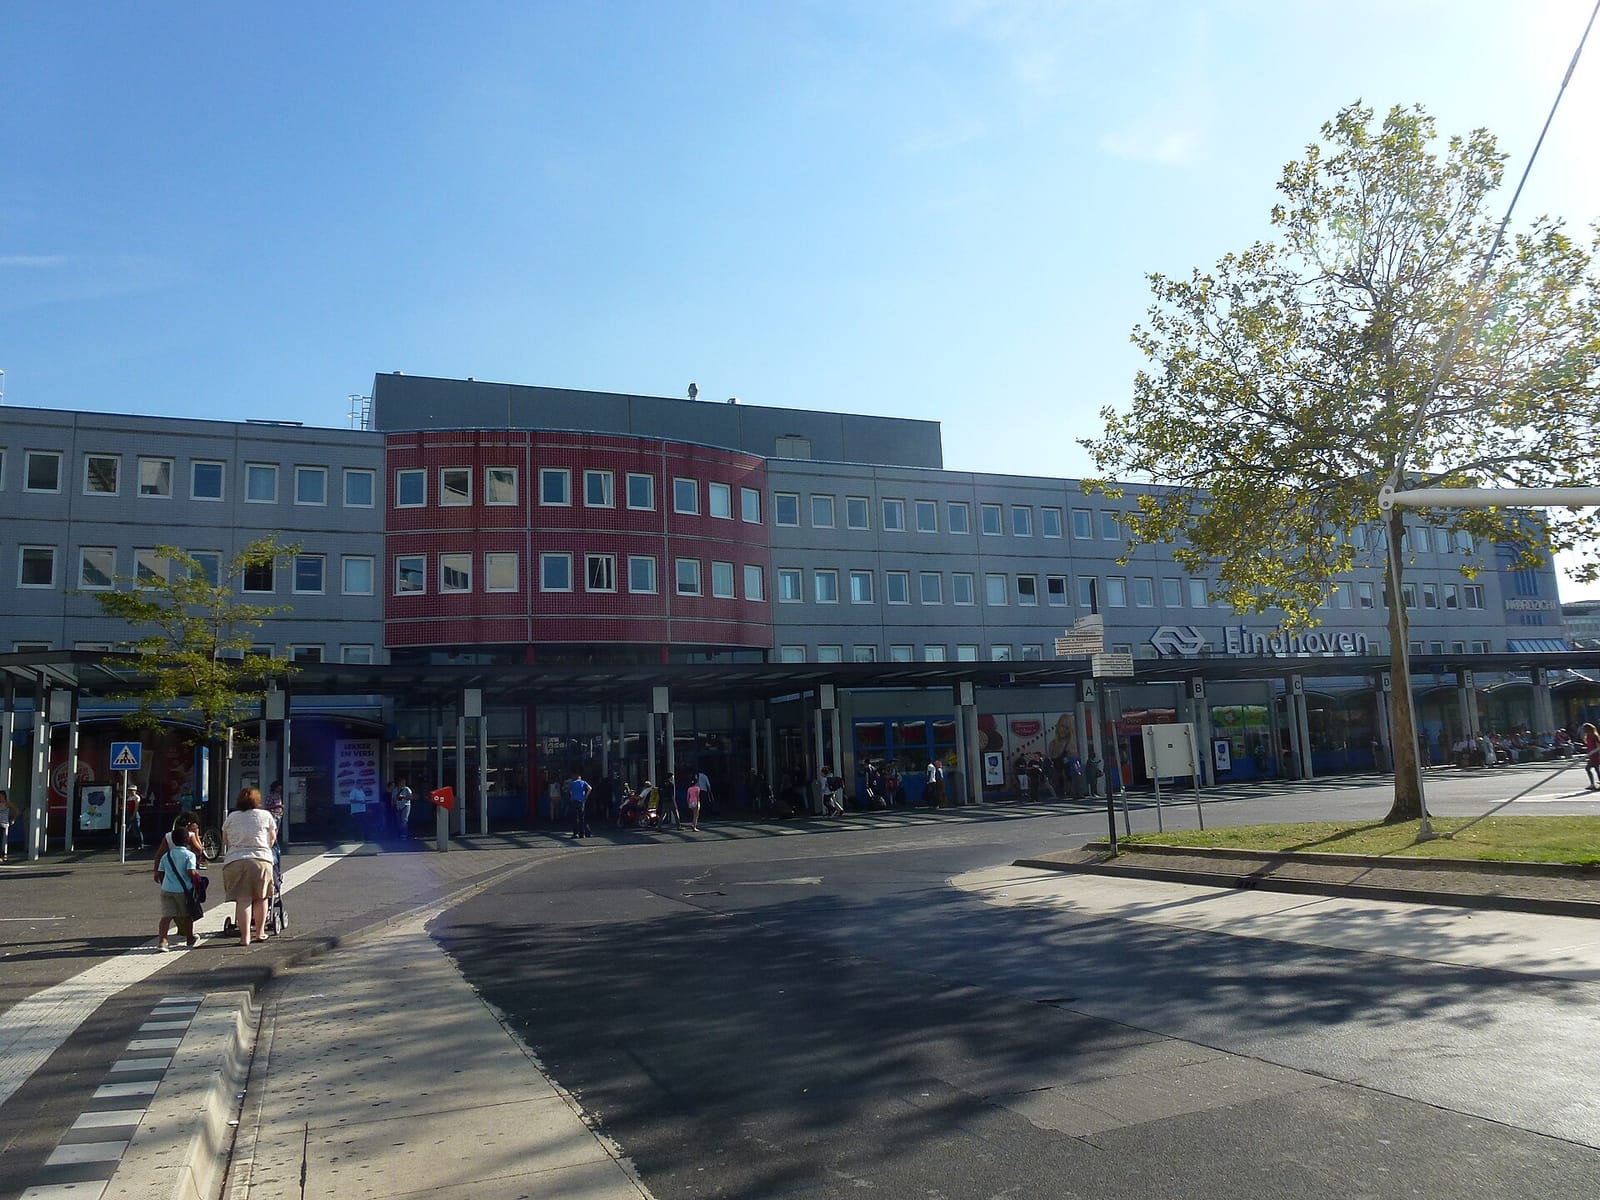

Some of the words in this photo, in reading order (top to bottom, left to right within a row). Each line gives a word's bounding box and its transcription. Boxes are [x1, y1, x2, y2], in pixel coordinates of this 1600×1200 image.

[1224, 625, 1369, 655] Eindhoven
[1294, 680, 1301, 690] C
[1384, 678, 1390, 687] D
[1085, 686, 1094, 697] A
[1195, 683, 1202, 693] B
